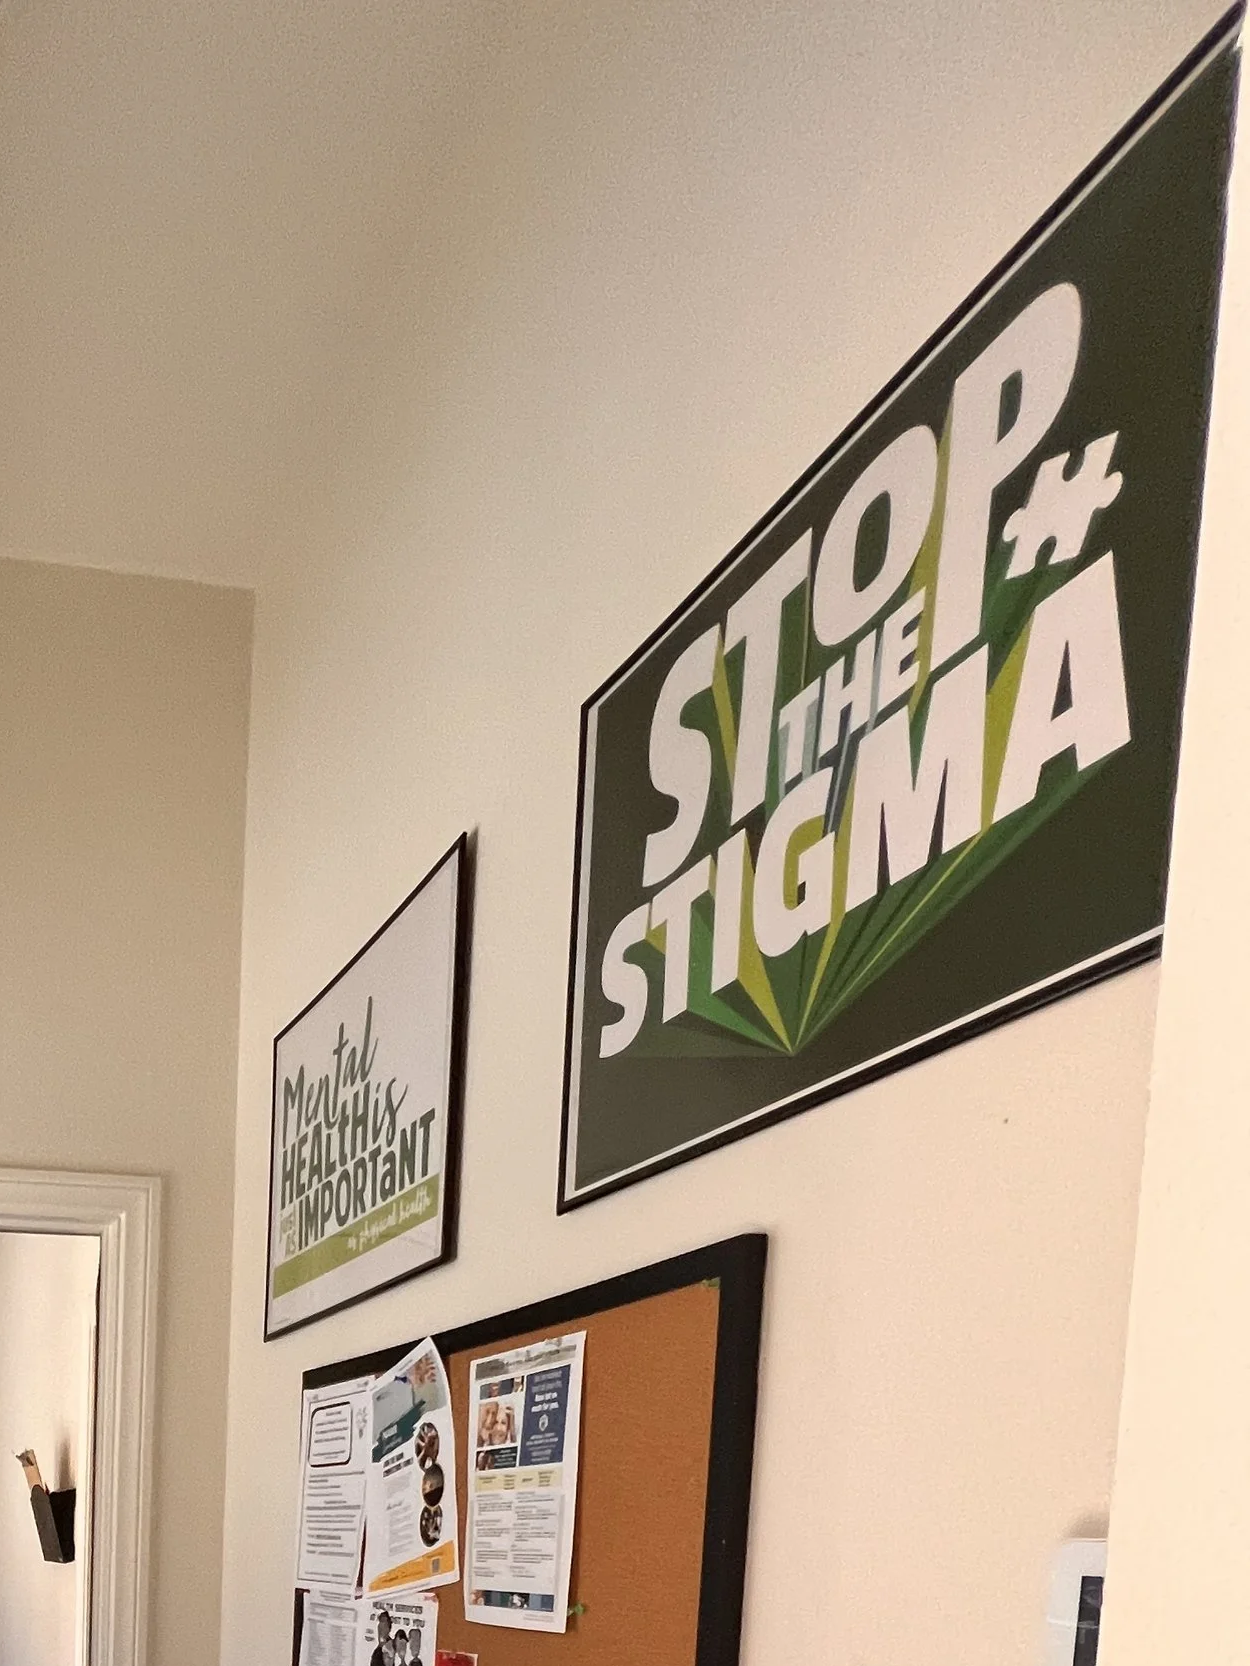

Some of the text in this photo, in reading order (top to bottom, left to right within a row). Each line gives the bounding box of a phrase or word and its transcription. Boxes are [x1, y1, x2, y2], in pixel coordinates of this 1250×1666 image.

[642, 280, 1083, 888] STOP
[779, 586, 927, 778] THE
[599, 550, 1132, 1060] STIGMA
[282, 996, 379, 1149] Mental
